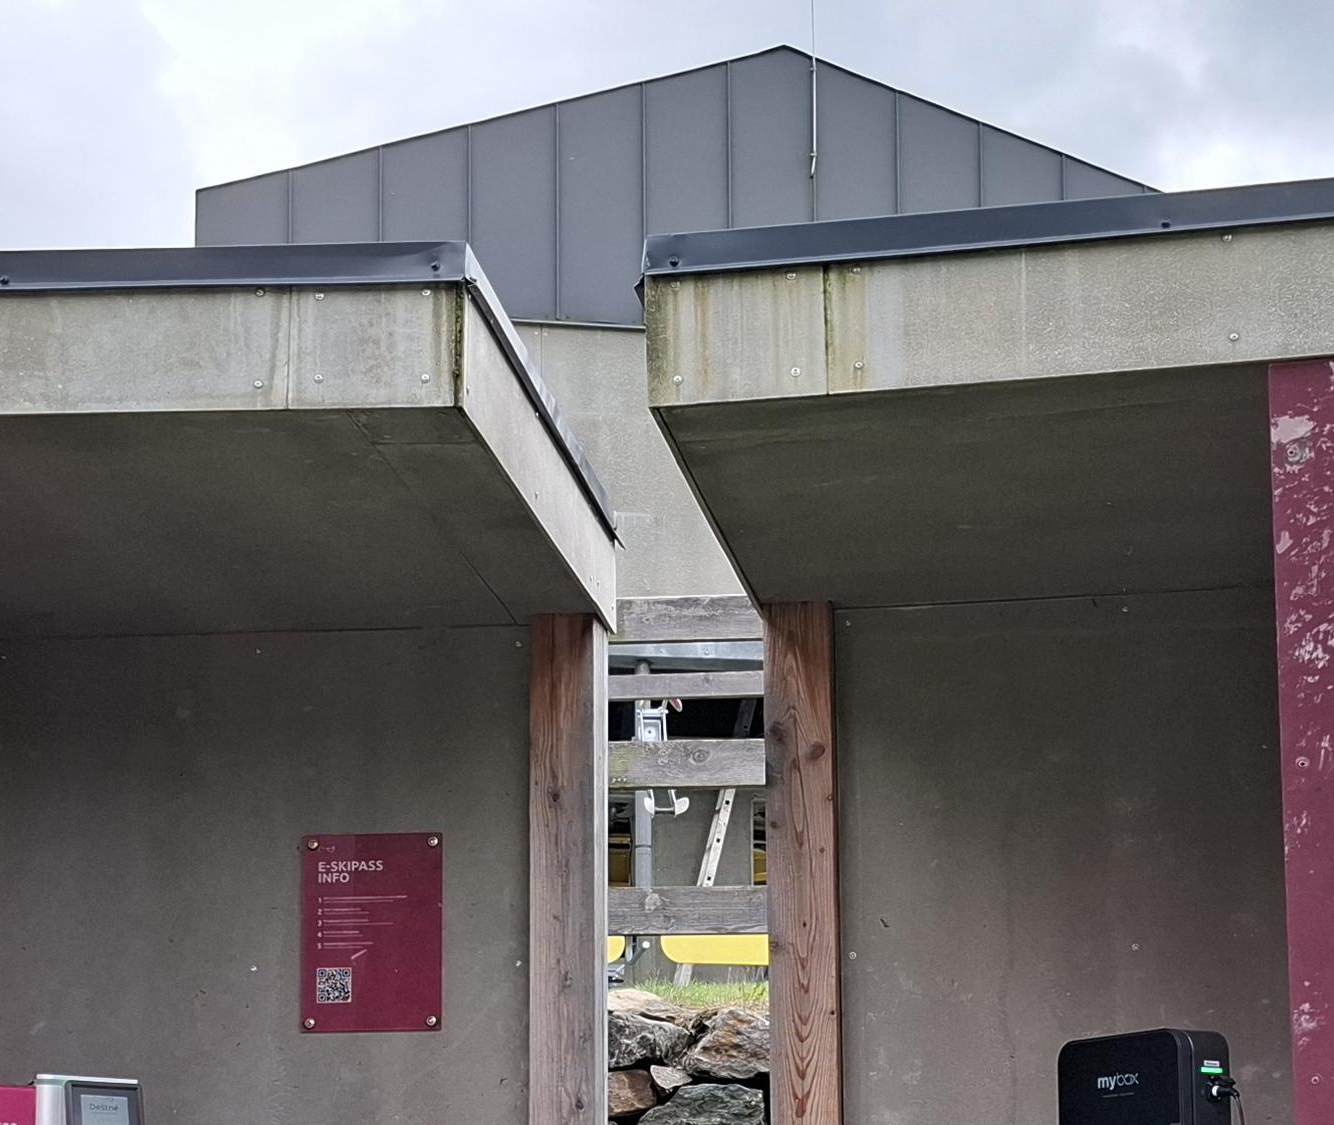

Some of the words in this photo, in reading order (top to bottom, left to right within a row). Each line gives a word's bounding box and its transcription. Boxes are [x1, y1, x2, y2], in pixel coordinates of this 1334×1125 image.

[317, 860, 384, 872] E-SKIPASS
[318, 872, 350, 884] INFO
[1097, 1072, 1139, 1090] mybox
